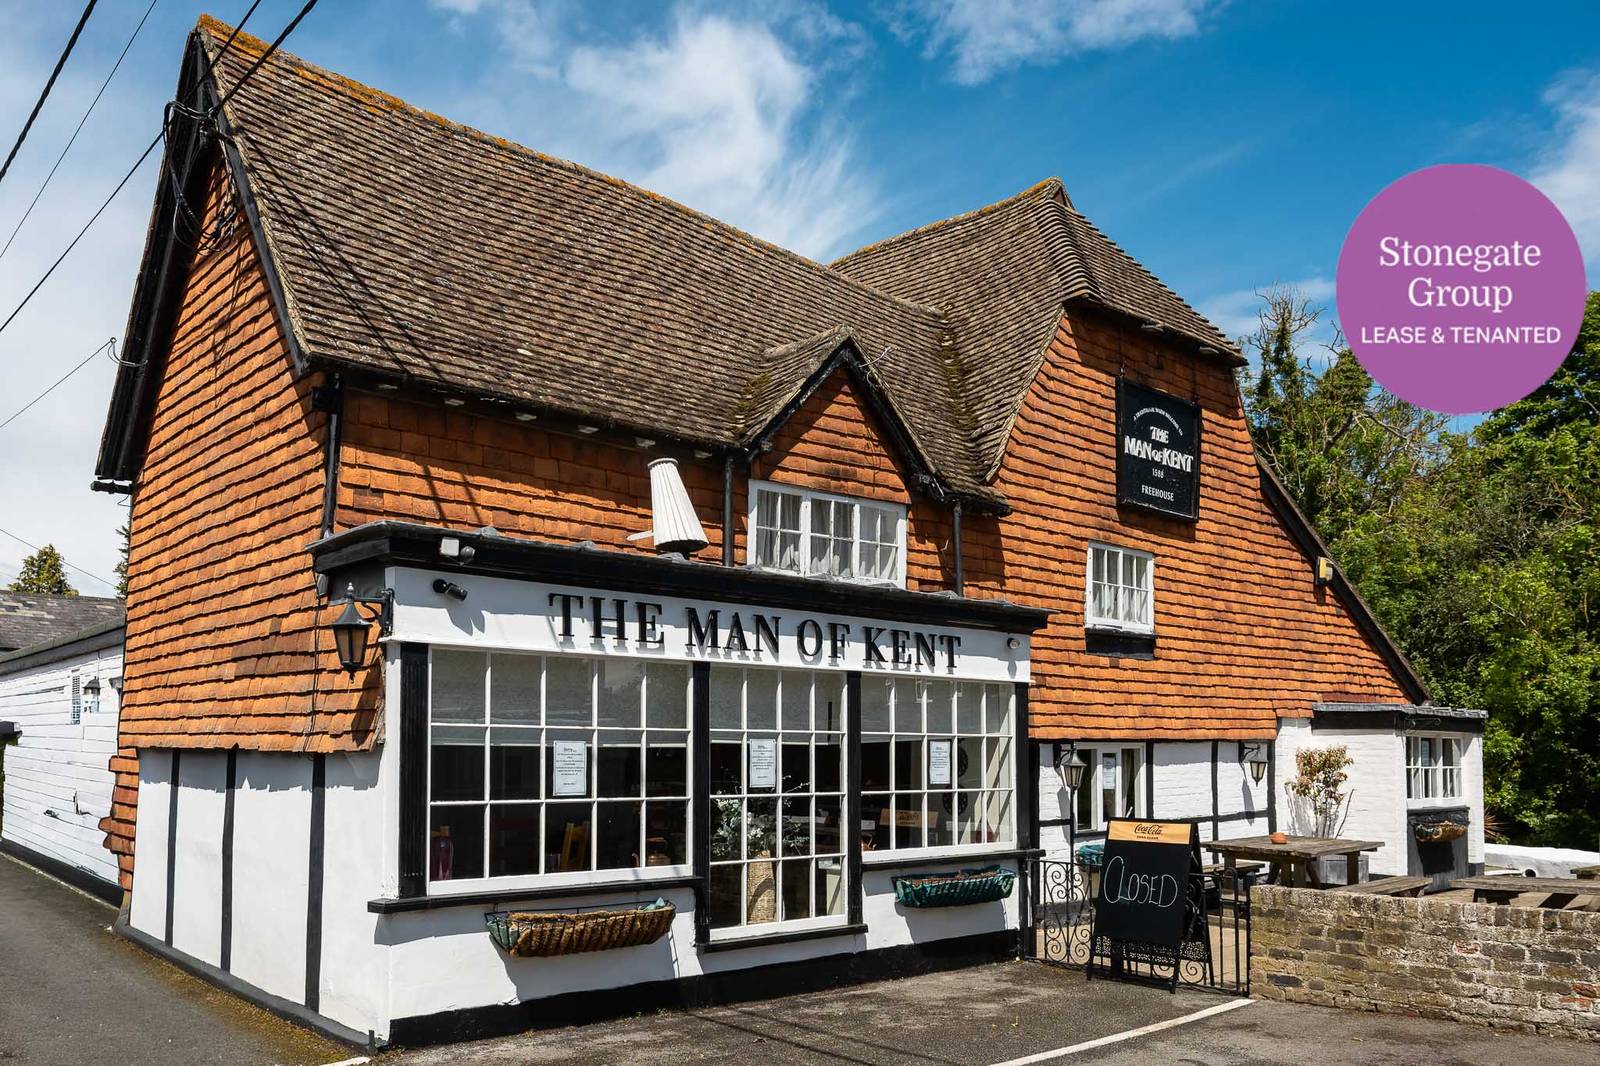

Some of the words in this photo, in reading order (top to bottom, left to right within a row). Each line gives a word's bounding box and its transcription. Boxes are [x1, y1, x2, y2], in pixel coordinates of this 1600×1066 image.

[1150, 426, 1169, 443] THE
[1124, 436, 1152, 461] MAN
[1162, 448, 1193, 472] KENT
[1141, 485, 1174, 501] FREEHOUSE
[548, 592, 665, 644] THE
[685, 606, 782, 654] MAN
[796, 619, 851, 659] OF
[862, 626, 962, 668] KENT
[1103, 855, 1178, 908] CLOSED
